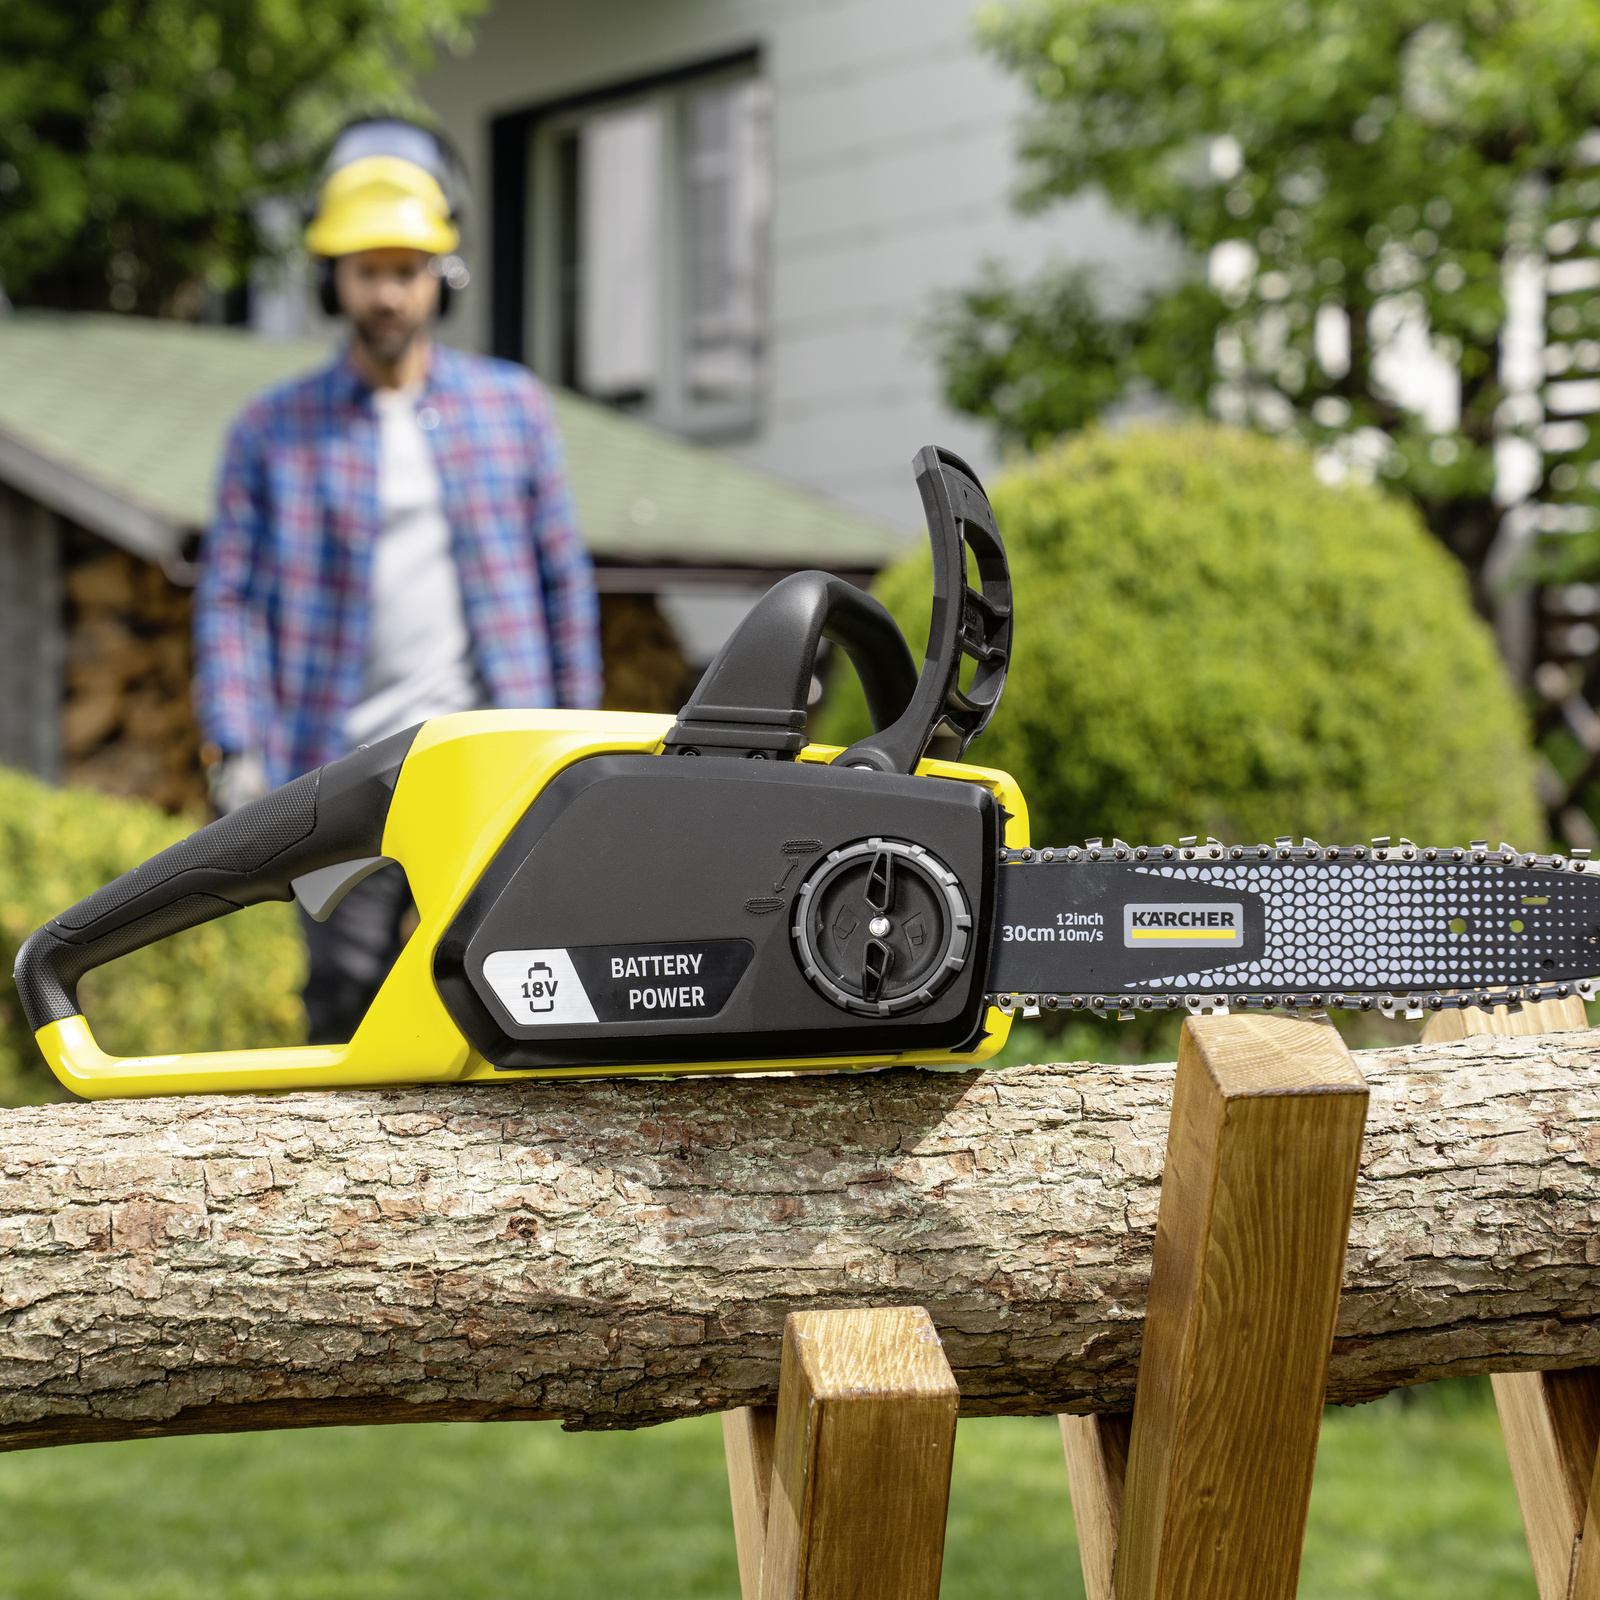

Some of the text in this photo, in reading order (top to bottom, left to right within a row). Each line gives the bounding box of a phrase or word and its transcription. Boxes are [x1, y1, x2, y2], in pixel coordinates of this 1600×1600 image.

[1056, 912, 1104, 926] 12inch
[1132, 911, 1235, 927] KÄRCHER
[1002, 925, 1104, 943] 30cm 10m/s
[611, 953, 703, 979] BATTERY
[521, 980, 559, 999] 18V
[629, 985, 706, 1010] POWER
